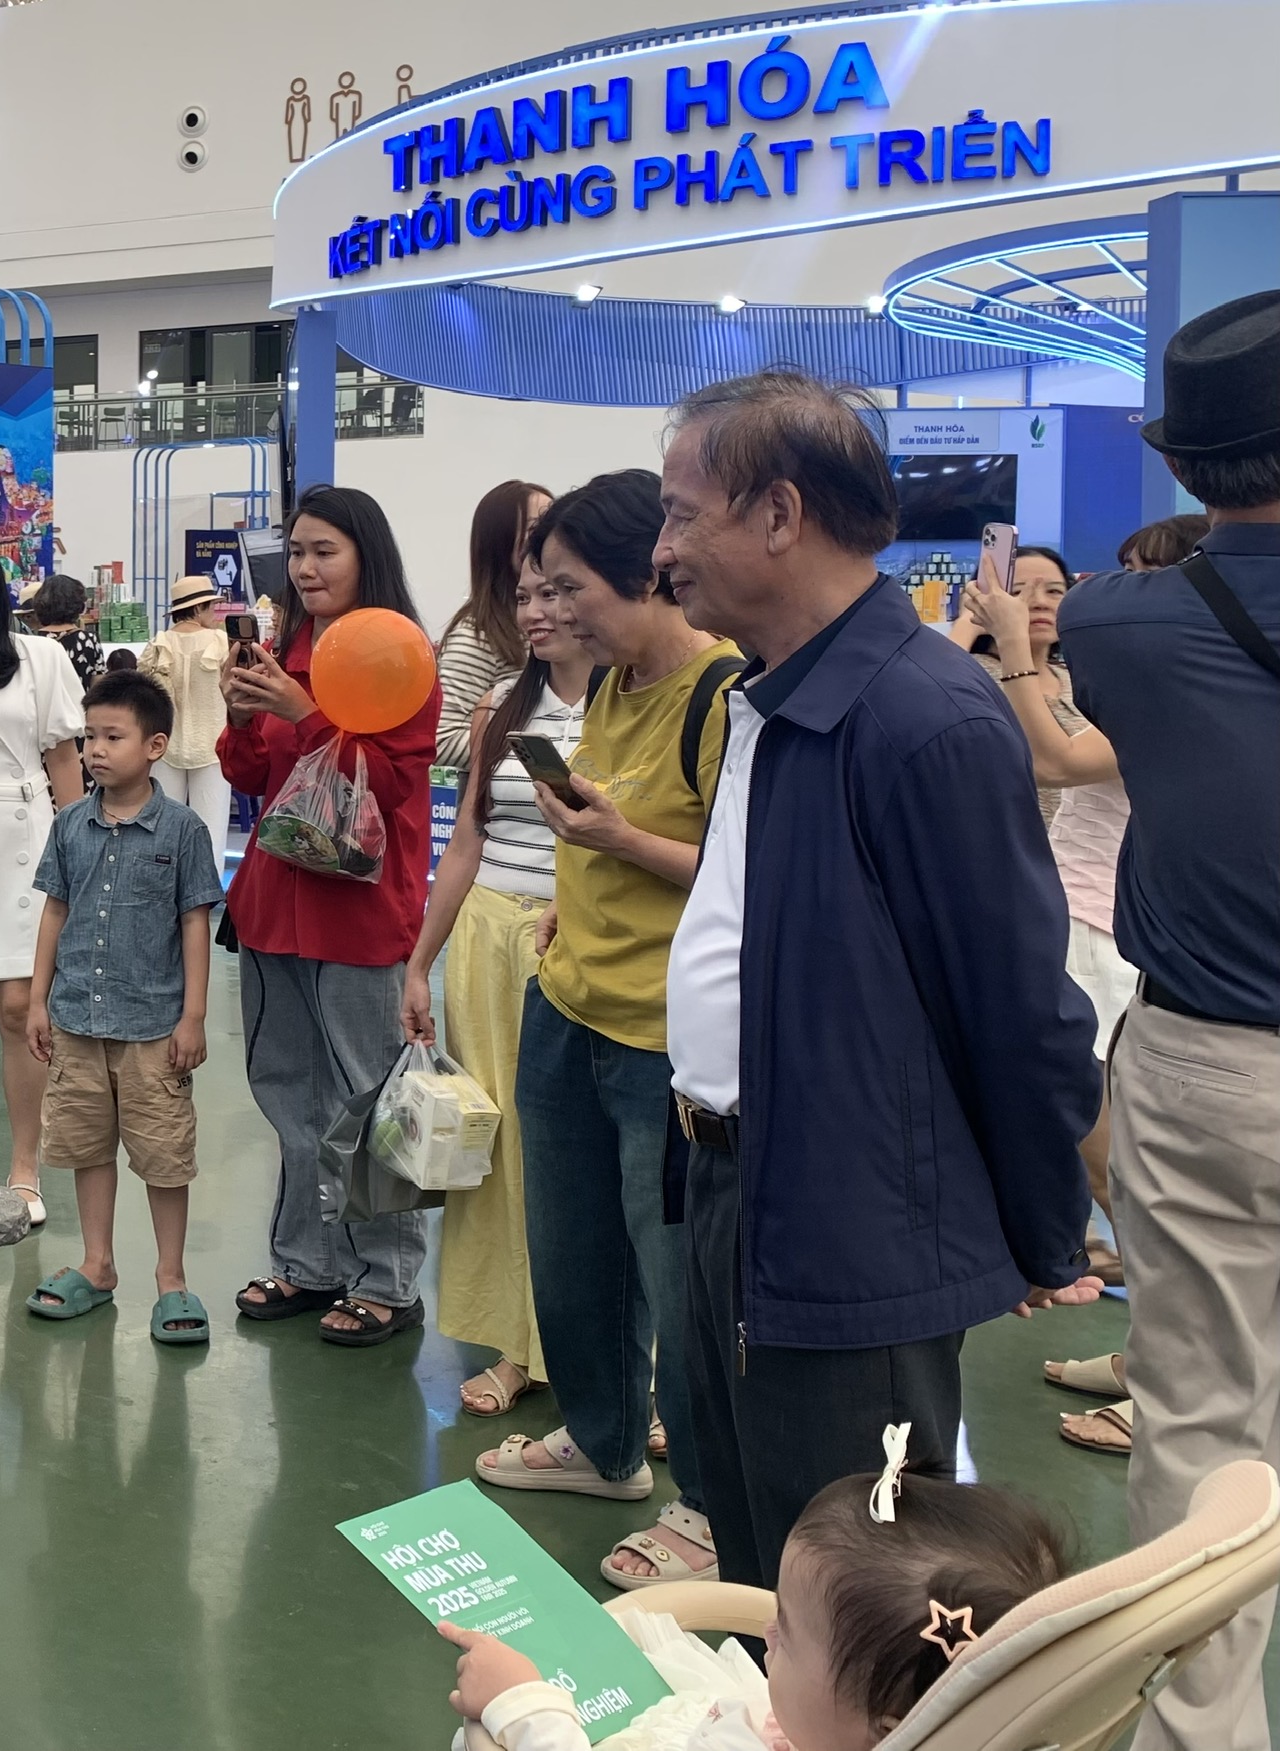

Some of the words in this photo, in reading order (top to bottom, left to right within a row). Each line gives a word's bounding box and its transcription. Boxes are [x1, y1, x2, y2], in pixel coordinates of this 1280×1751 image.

[383, 76, 633, 192] THANH
[665, 34, 890, 133] HÓA
[329, 215, 388, 279] KẾT
[389, 191, 461, 258] NỐI
[466, 169, 617, 238] CÙNG
[633, 132, 814, 211] PHÁT
[830, 109, 1051, 190] TRIỂN
[913, 425, 943, 433] THANH
[945, 424, 965, 433] HÓA
[381, 1544, 424, 1570] HỘI
[417, 1528, 461, 1556] CHỢ
[403, 1564, 455, 1594] MÙA
[444, 1551, 487, 1577] THU
[427, 1586, 480, 1617] 2025
[483, 1619, 500, 1630] CON
[510, 1615, 535, 1631] DOANH
[576, 1686, 634, 1727] NGHIỆM
